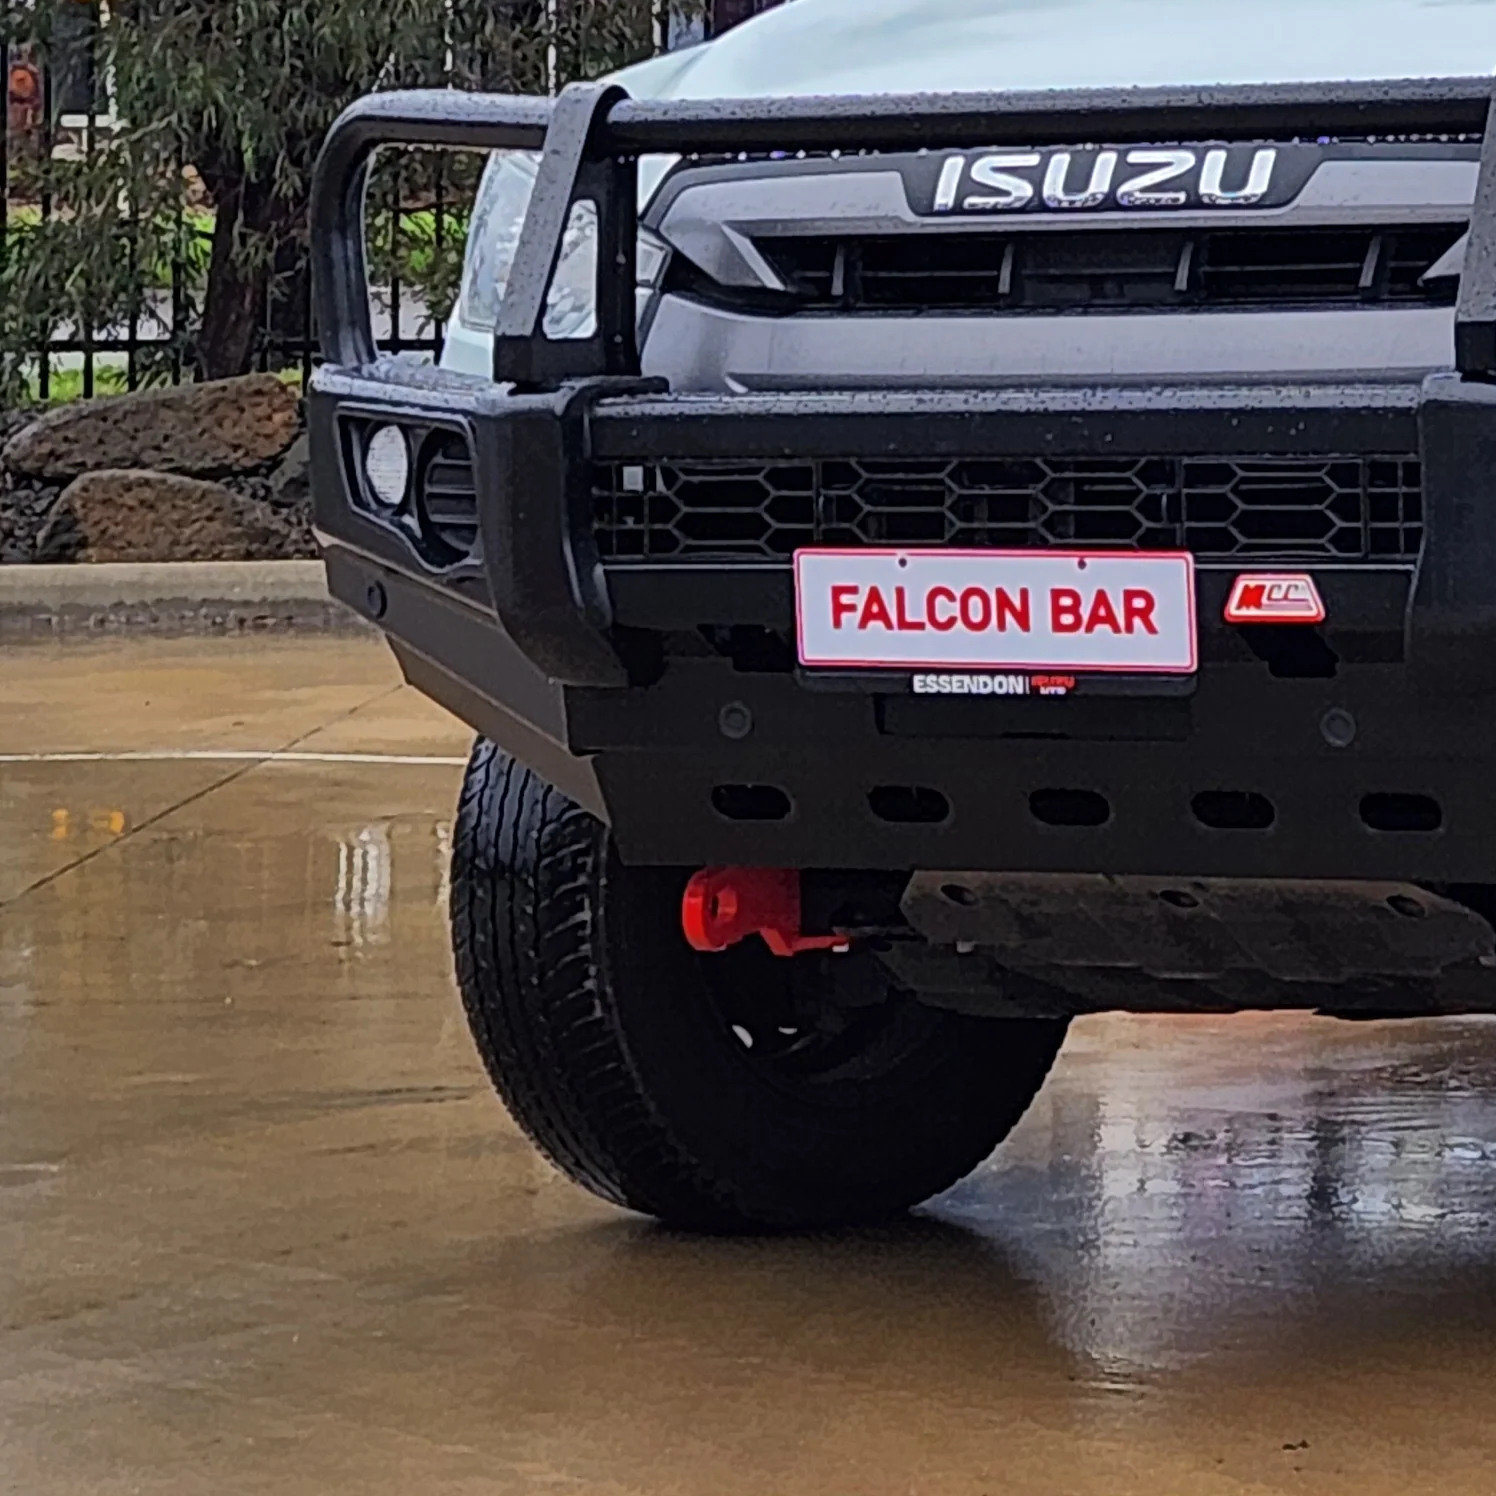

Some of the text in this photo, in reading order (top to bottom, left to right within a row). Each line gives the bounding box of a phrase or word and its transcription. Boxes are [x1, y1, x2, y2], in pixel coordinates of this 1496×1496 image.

[932, 148, 1277, 212] ISUZU
[830, 584, 1159, 635] FALCON BAR
[913, 674, 1024, 695] ESSENDON
